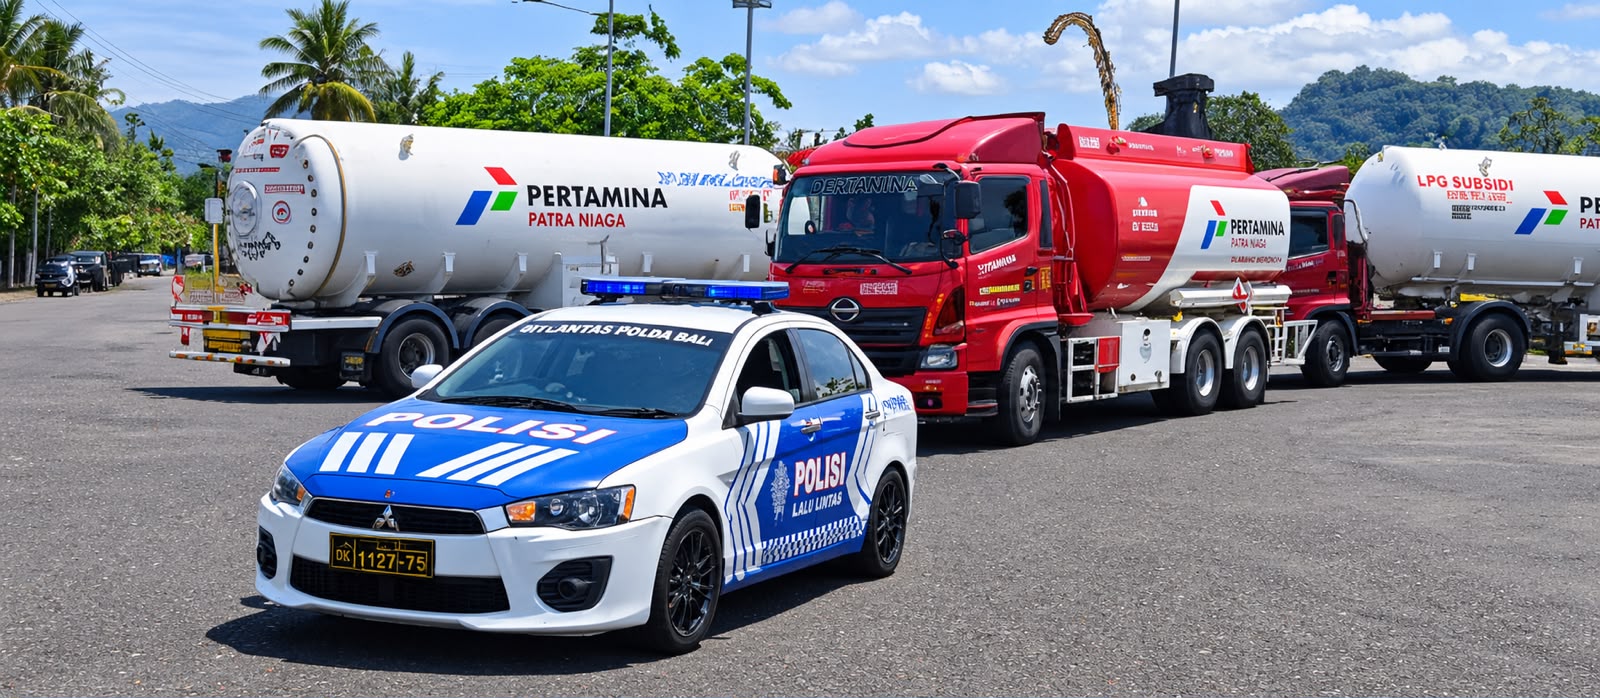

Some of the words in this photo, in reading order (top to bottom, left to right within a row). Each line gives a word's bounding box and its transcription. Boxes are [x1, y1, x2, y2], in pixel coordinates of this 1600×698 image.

[1417, 175, 1448, 188] LPG
[1452, 176, 1513, 191] SUBSIDI
[527, 184, 668, 208] PERTAMINA
[528, 212, 575, 227] PATRA
[579, 213, 626, 228] NIAGA
[1231, 219, 1285, 236] PERTAMINA
[614, 325, 673, 341] POLDA
[673, 332, 714, 347] BALI
[365, 412, 617, 444] POLISI
[793, 452, 846, 497] POLISI
[792, 501, 814, 517] LALU
[815, 491, 842, 511] LINTAS
[336, 549, 351, 562] DK
[358, 550, 426, 572] 1127-75
